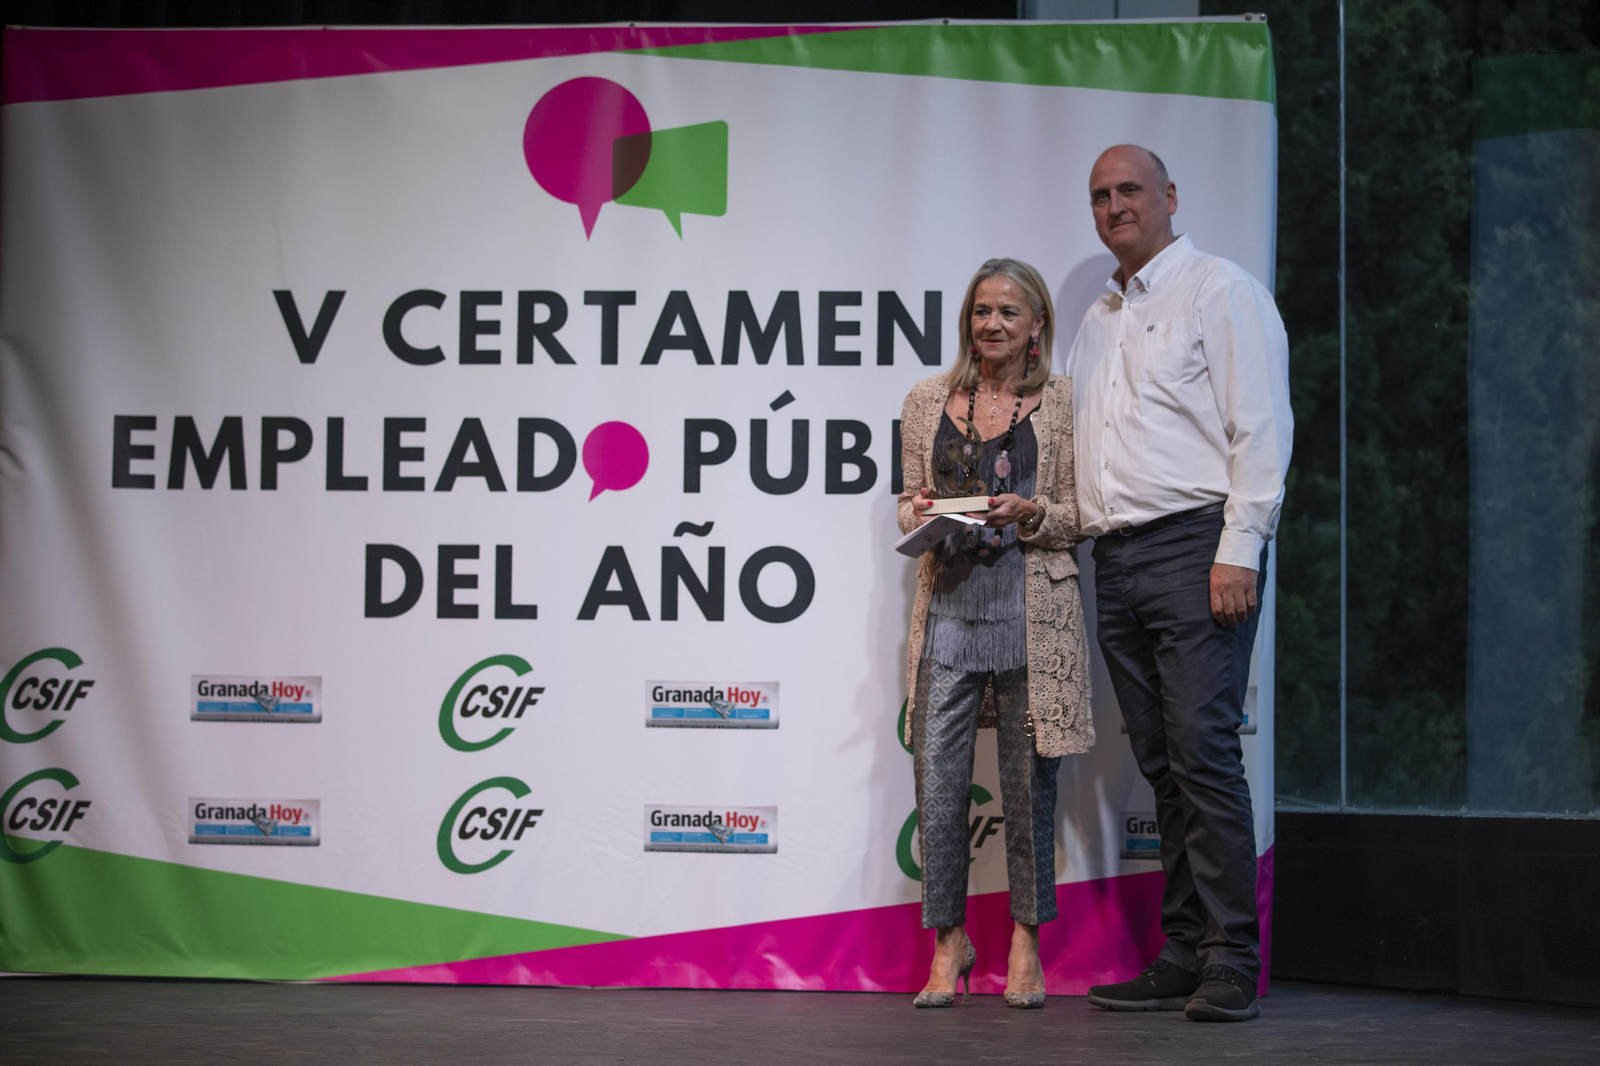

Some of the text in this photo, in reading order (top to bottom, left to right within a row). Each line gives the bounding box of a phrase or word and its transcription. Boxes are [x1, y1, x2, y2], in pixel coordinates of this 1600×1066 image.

[273, 289, 943, 366] V CERTAMEN
[365, 521, 816, 623] DEL AÑO
[12, 677, 95, 711] CSIF
[197, 680, 305, 702] Granada Hoy
[459, 684, 545, 719] CSIF
[652, 686, 761, 708] Granada Hoy
[8, 797, 92, 832] CSIF
[195, 803, 303, 825] Granada Hoy
[458, 806, 544, 841] CSIF
[650, 810, 760, 832] Granada Hoy
[1126, 816, 1157, 834] Gra
